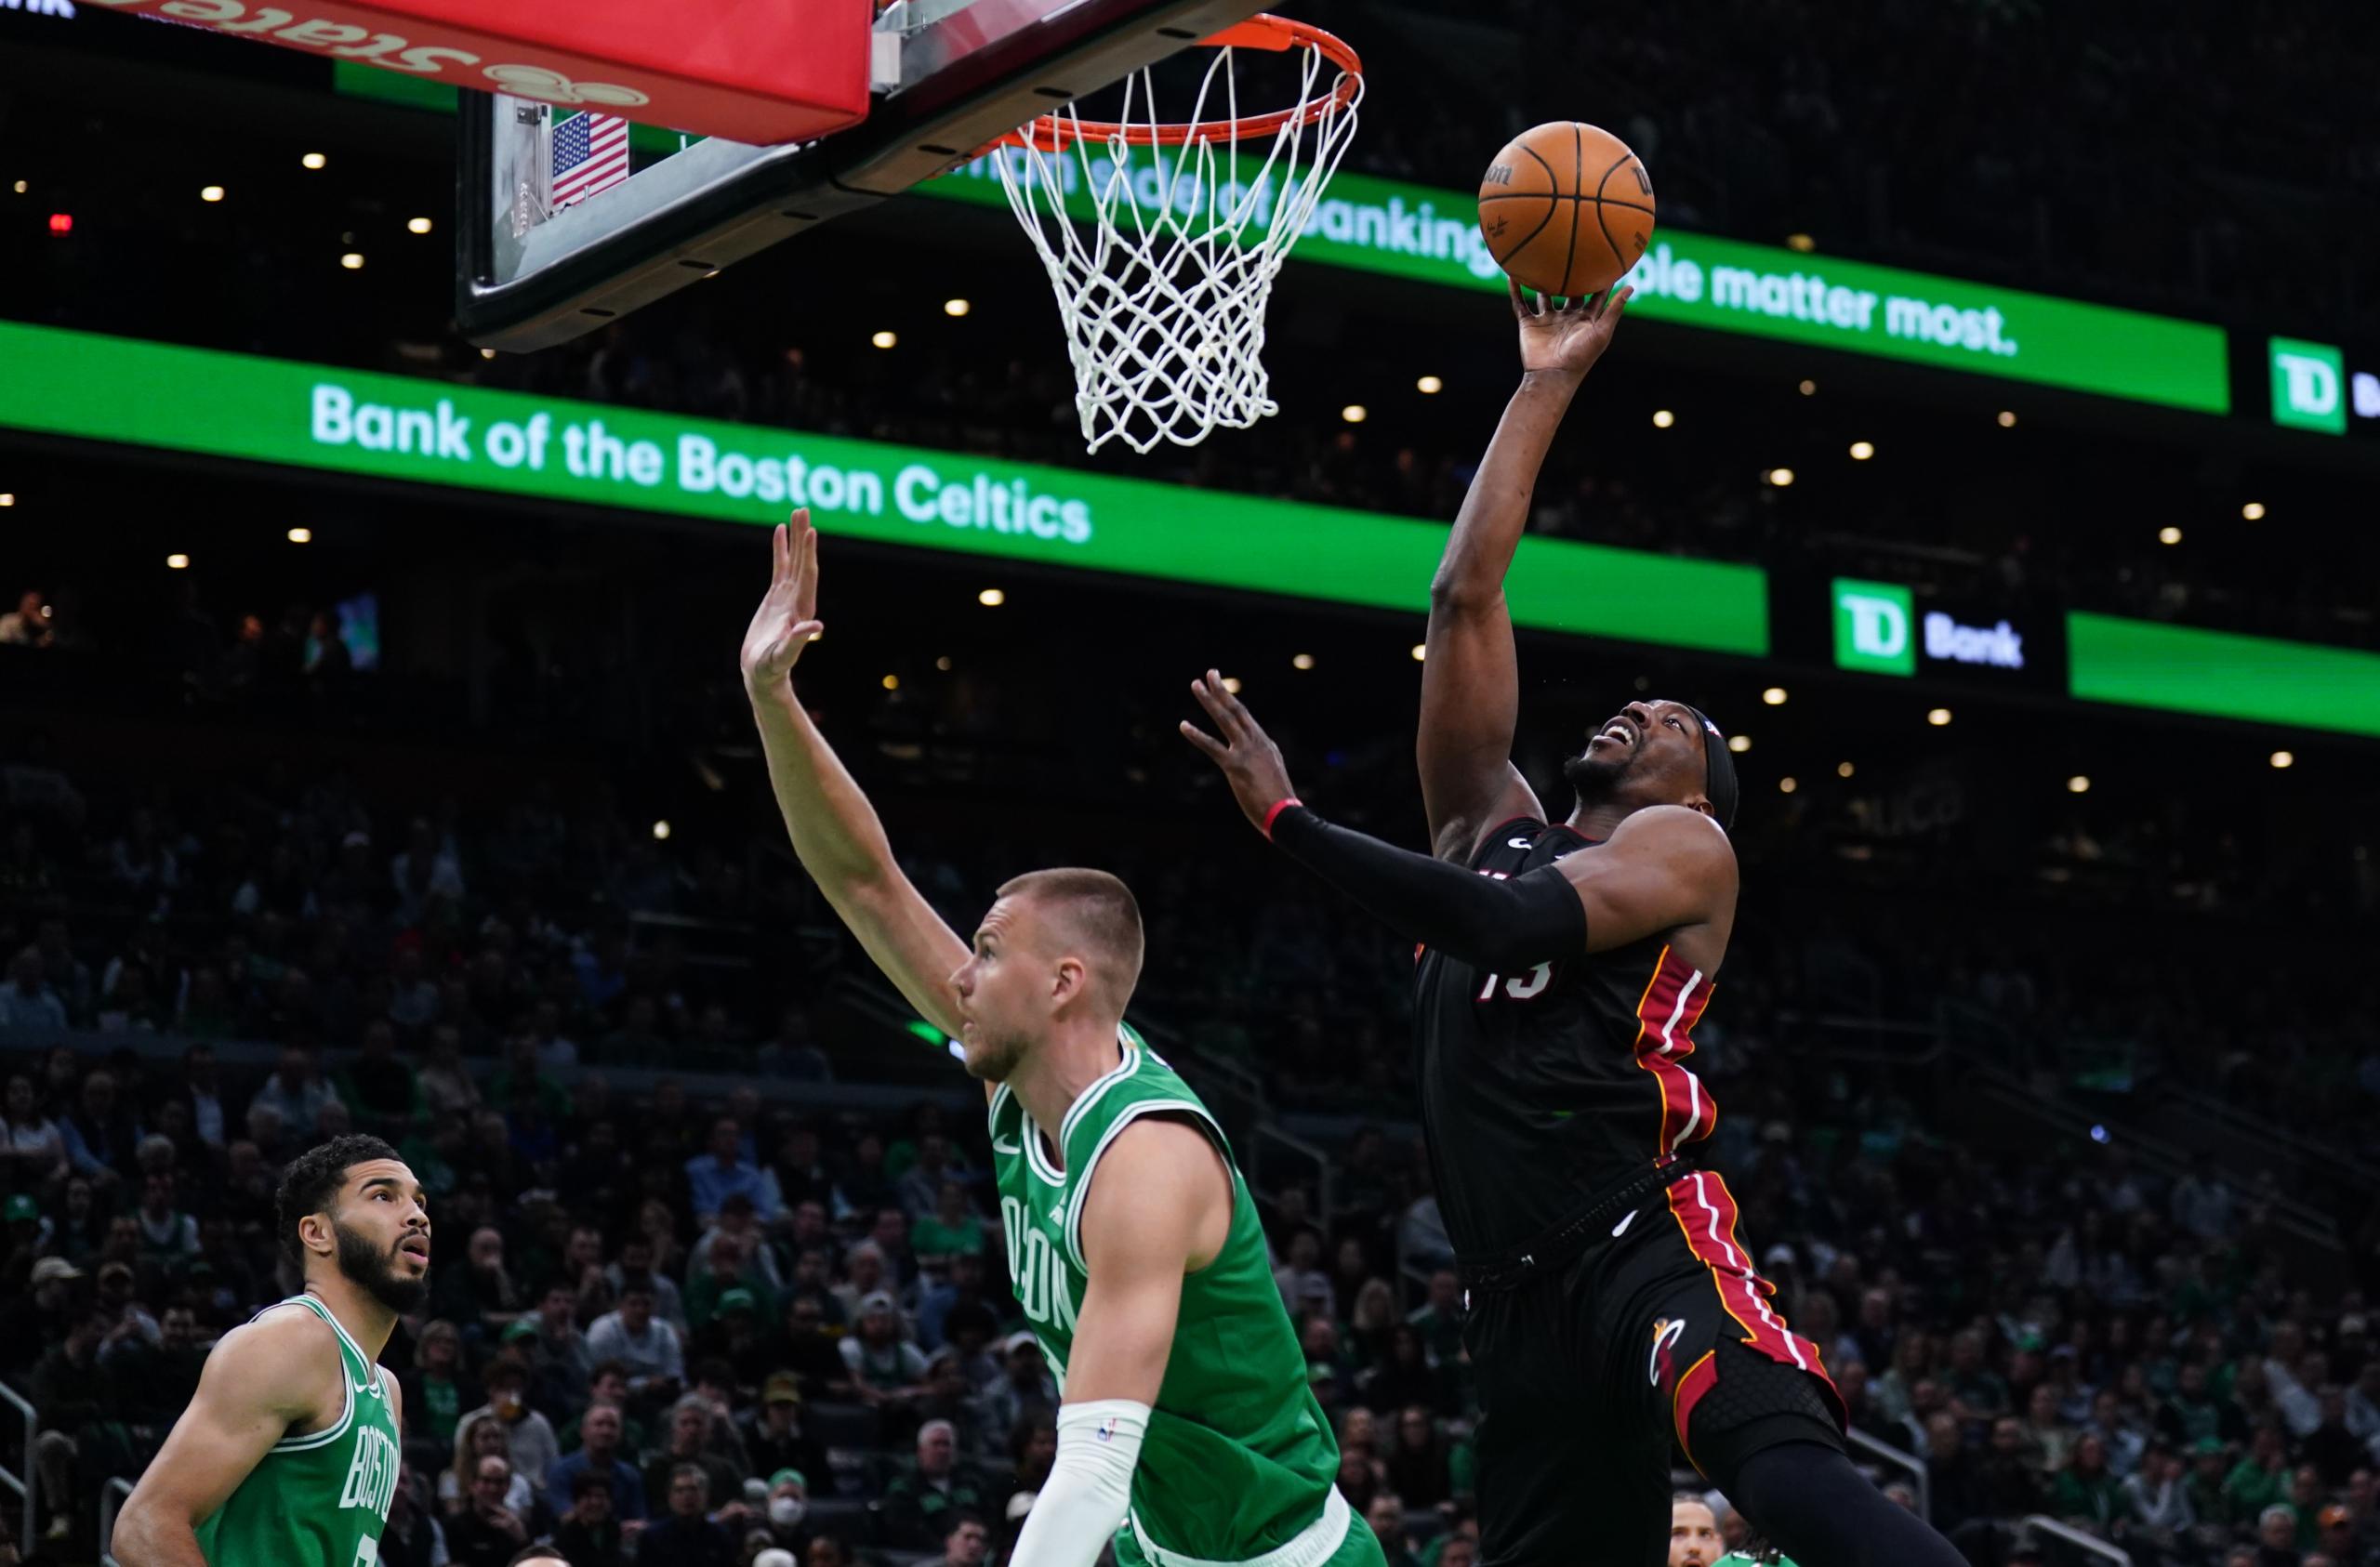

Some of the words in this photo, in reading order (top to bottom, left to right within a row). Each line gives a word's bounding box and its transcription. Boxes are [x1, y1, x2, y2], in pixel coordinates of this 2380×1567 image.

[159, 1, 480, 72] State
[1089, 147, 1207, 216] side
[1216, 175, 1275, 229] of
[1288, 177, 1502, 278] banking
[1620, 243, 1704, 303] ple
[1711, 265, 1878, 331] matter
[1884, 295, 2018, 357] most.
[2275, 352, 2339, 415] TD
[311, 384, 471, 461] Bank
[484, 412, 550, 470] of
[562, 420, 664, 486] the
[677, 433, 883, 516] Boston
[893, 465, 1093, 544] Celtics
[1839, 594, 1906, 658] TD
[1924, 611, 2024, 669] Bank
